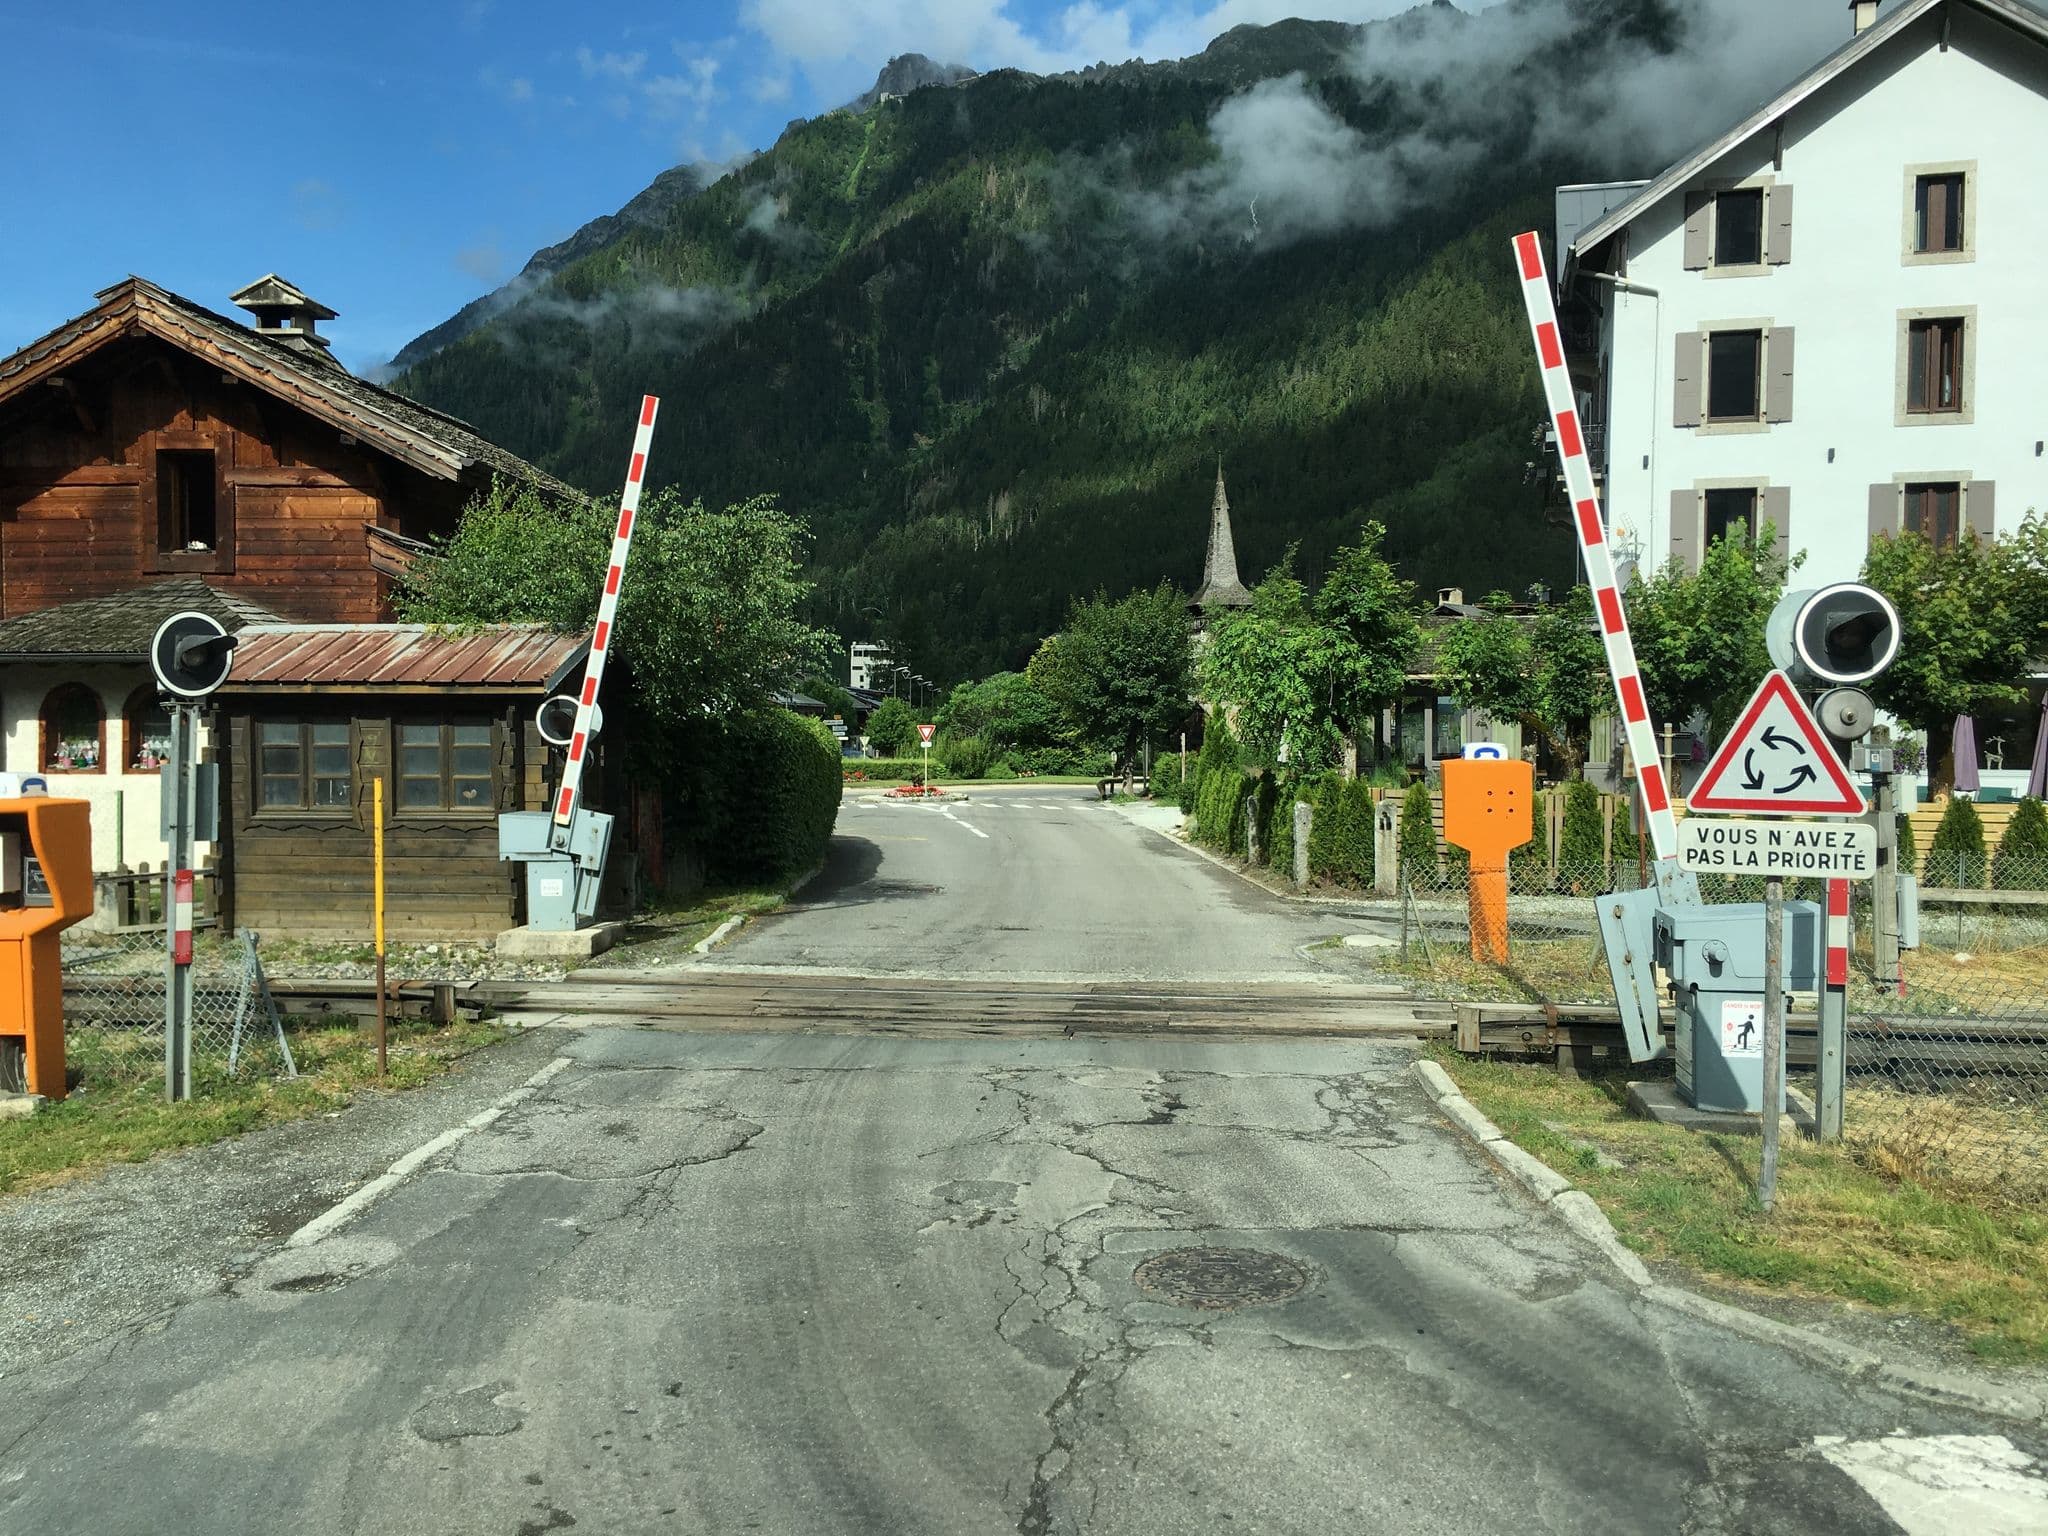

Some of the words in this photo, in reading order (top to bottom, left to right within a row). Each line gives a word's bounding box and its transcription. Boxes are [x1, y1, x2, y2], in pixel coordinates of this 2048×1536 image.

[1697, 828, 1757, 844] VOUS
[1768, 830, 1856, 848] N'AVEZ
[1686, 848, 1725, 865] PAS
[1732, 850, 1759, 866] LA
[1768, 850, 1866, 871] PRIORITÉ
